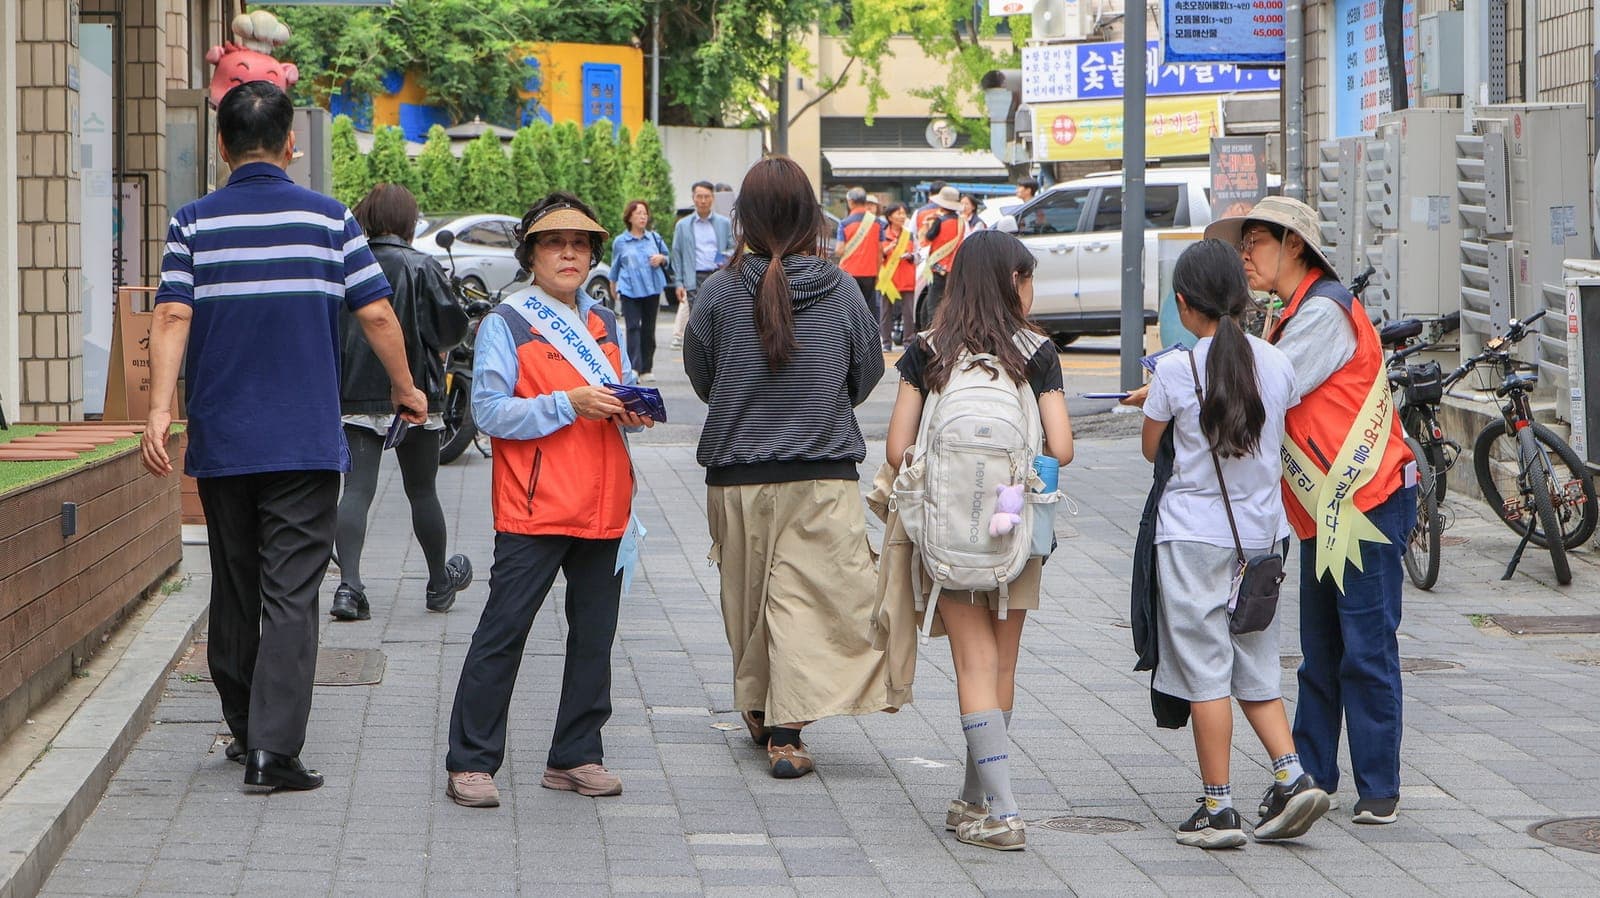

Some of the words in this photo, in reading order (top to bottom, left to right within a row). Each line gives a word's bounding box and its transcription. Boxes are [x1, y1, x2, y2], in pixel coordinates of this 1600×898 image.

[1253, 28, 1283, 38] 45,000
[1152, 111, 1200, 137] 삼계탕
[975, 461, 986, 489] new
[969, 491, 987, 544] balance
